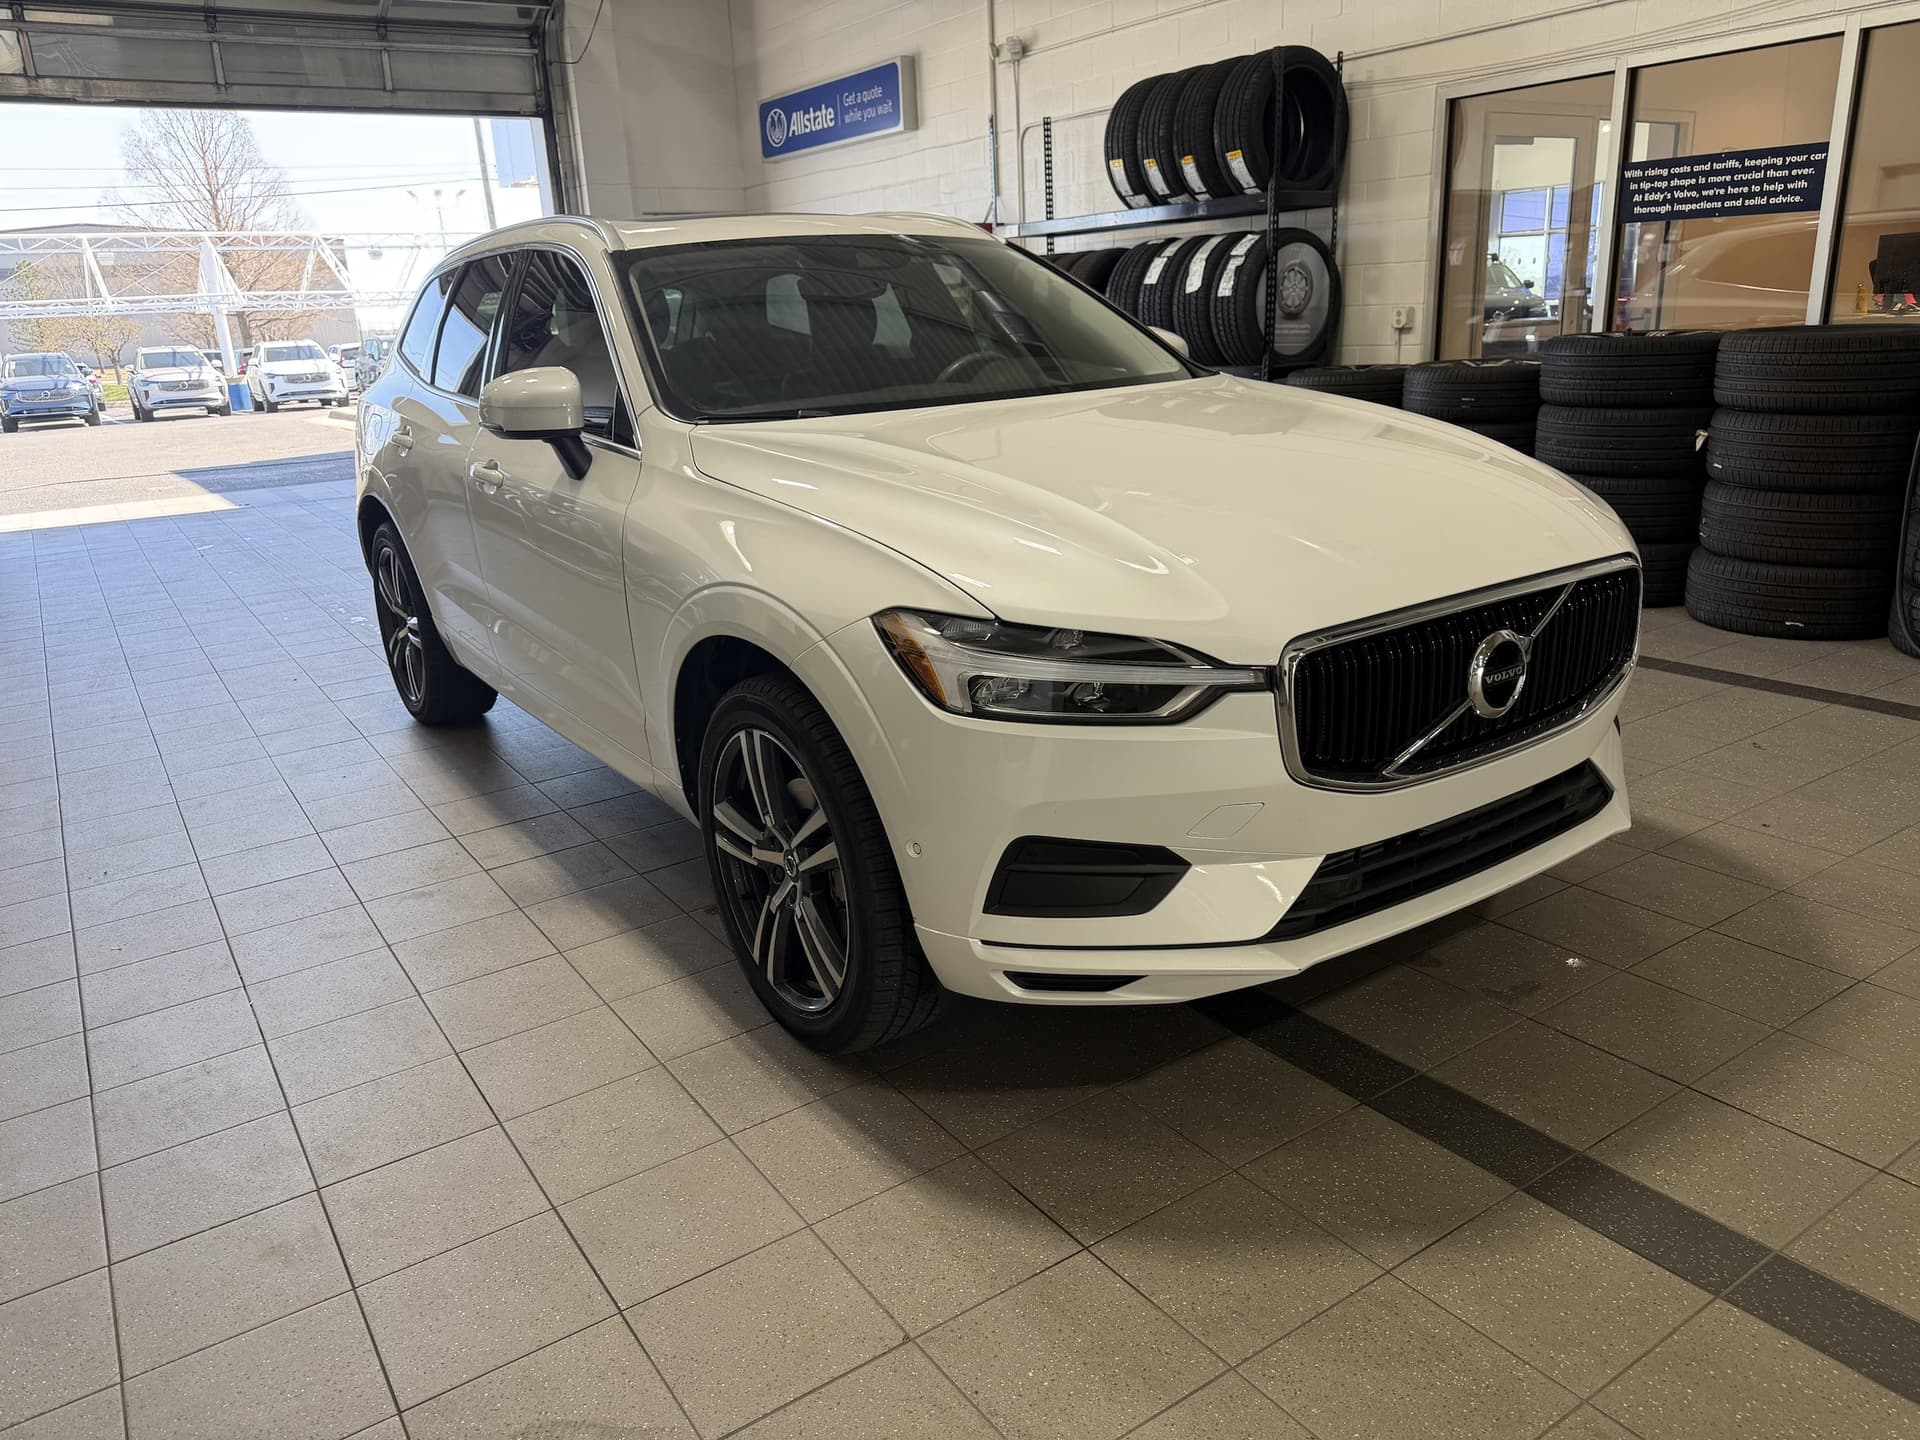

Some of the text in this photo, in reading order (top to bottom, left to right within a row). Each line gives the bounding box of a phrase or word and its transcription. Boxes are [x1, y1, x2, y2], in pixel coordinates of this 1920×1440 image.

[843, 92, 856, 106] Get
[862, 86, 883, 102] quote
[788, 104, 835, 137] Allstate
[845, 101, 893, 124] while you wait
[1624, 152, 1827, 178] With rising costs and tariffs, keeping your car
[1629, 167, 1816, 190] in tip-top shape is more crucial than ever.
[1632, 179, 1808, 202] At Eddy's Volvo, we're here to help with
[1633, 194, 1804, 215] thorough inspections and solid advice.
[1485, 666, 1523, 684] VOLVO
